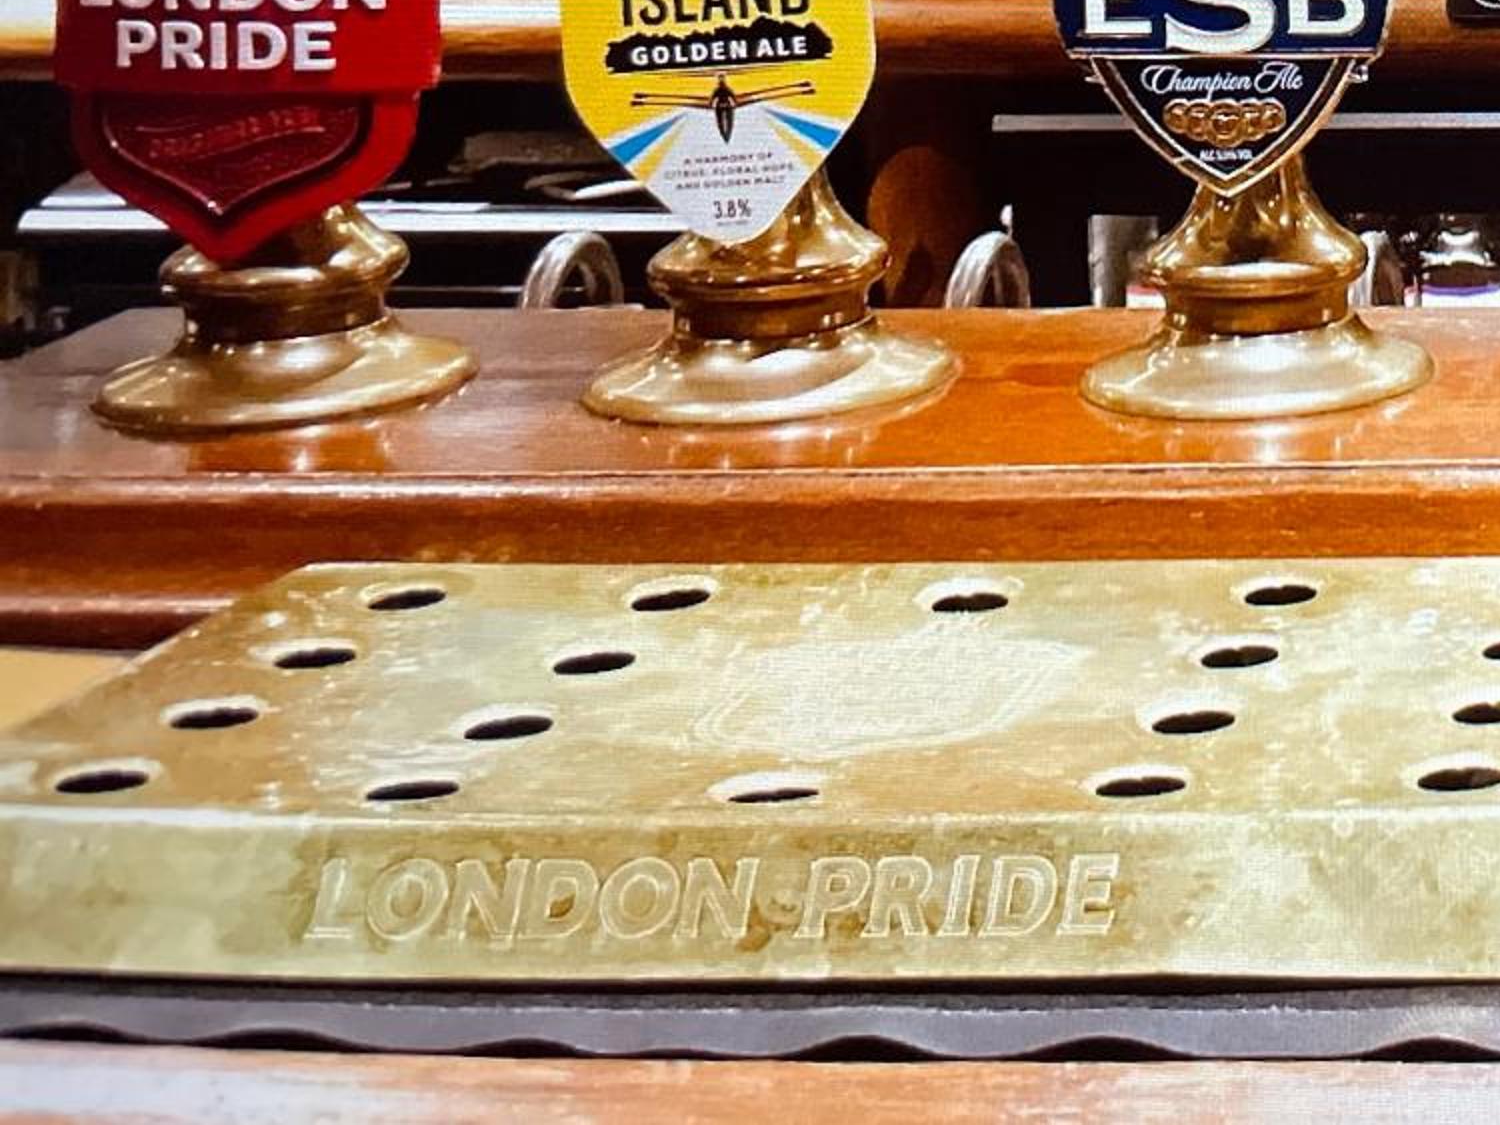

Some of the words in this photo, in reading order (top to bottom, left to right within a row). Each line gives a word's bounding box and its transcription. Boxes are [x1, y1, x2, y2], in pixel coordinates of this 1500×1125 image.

[116, 19, 337, 72] PRIDE
[630, 39, 749, 66] GOLDEN
[756, 35, 809, 60] ALE
[1141, 65, 1253, 102] Champion
[1253, 61, 1304, 93] Ale
[713, 198, 752, 219] 3.8%
[303, 856, 762, 941] LONDON
[793, 852, 1121, 939] PRIDE
